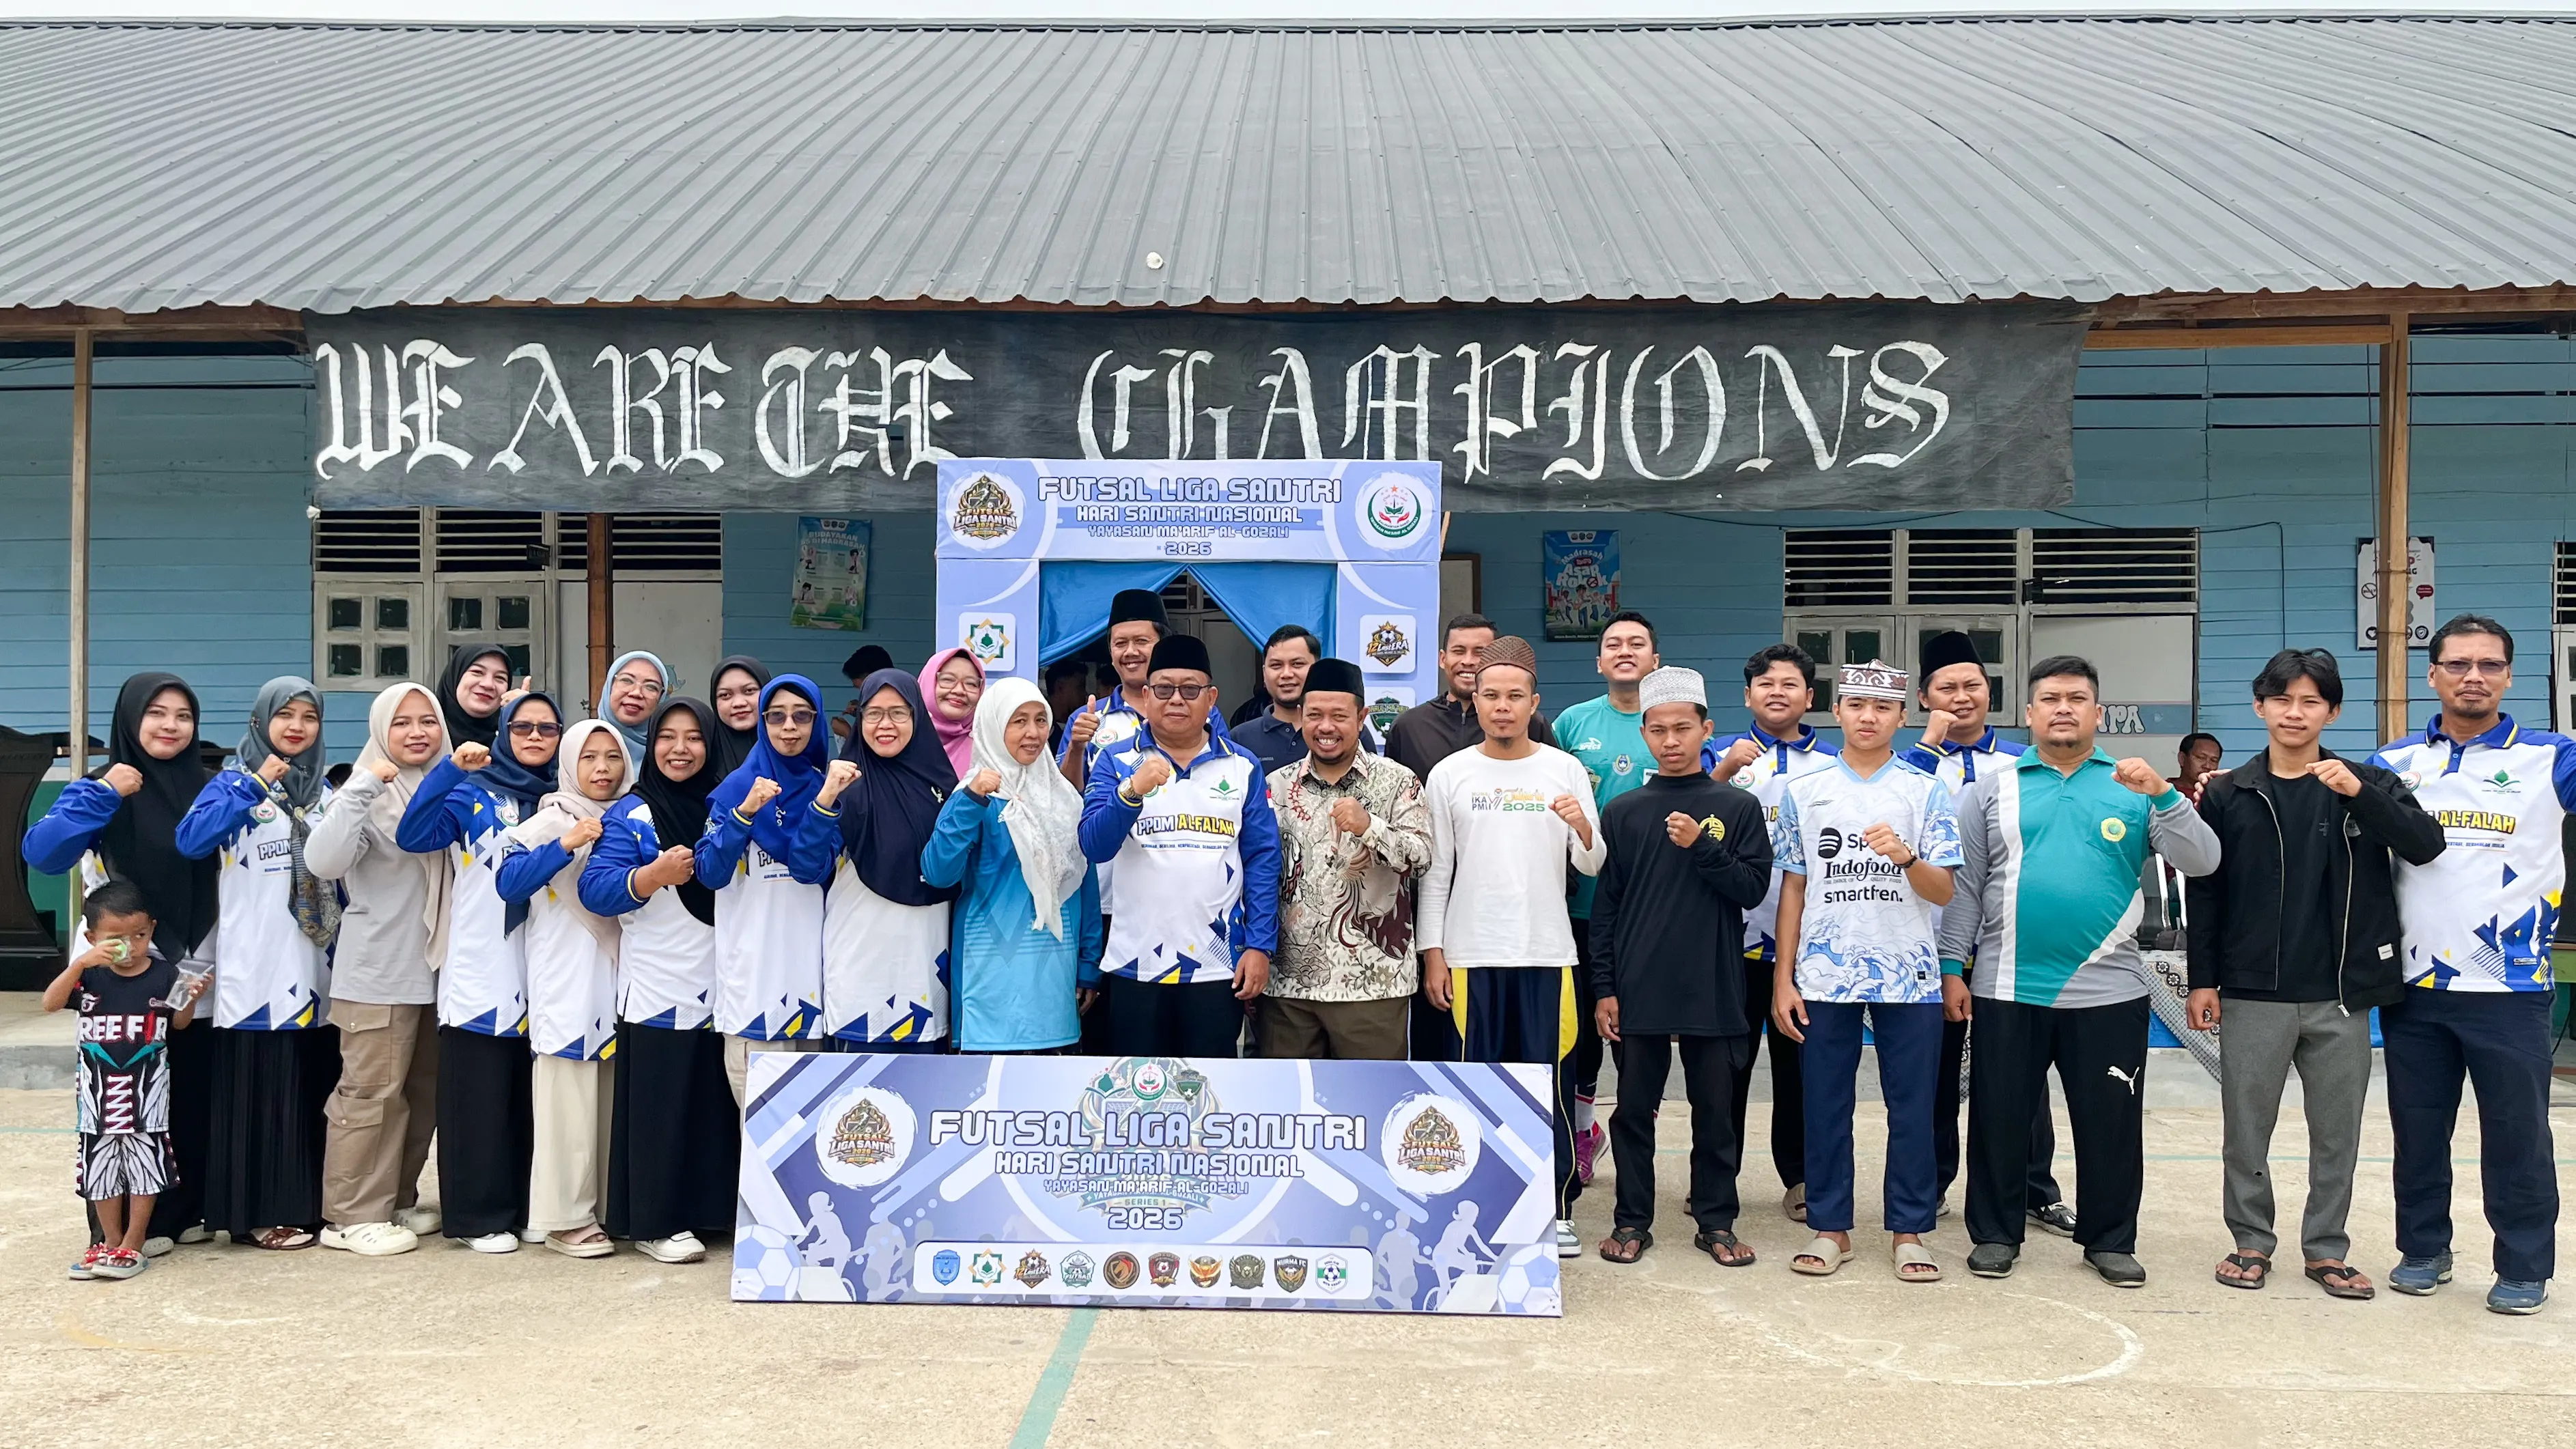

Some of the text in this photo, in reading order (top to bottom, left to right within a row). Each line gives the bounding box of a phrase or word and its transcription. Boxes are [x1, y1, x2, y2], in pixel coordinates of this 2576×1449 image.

[317, 339, 476, 480] WE
[487, 342, 732, 477] ARE
[754, 345, 975, 480] THE
[1038, 477, 1341, 503] FUTSAL LIGA SANTRI
[966, 508, 1007, 516] FUTSAL
[1076, 506, 1303, 522] HARI SANTRI NASIONAL
[1088, 526, 1289, 538] YAYASAN MA'ARIF AL-GOZALI
[1165, 541, 1212, 555] 2026
[1561, 549, 1604, 565] Madrasah
[1502, 803, 1545, 811] 2025
[1823, 858, 1903, 882] Indofood
[843, 1134, 885, 1142] FUTSAL
[929, 1110, 1366, 1151] FUTSAL LIGA SANTRI
[830, 1140, 895, 1155] LIGA SANTRI
[1400, 1147, 1466, 1162] LIGA SANTRI
[995, 1151, 1304, 1177] HARI SANTRI NASIONAL
[1044, 1179, 1249, 1194] YAYASAN MA'ARIF AL-GOZALI
[1108, 1207, 1183, 1230] 2026
